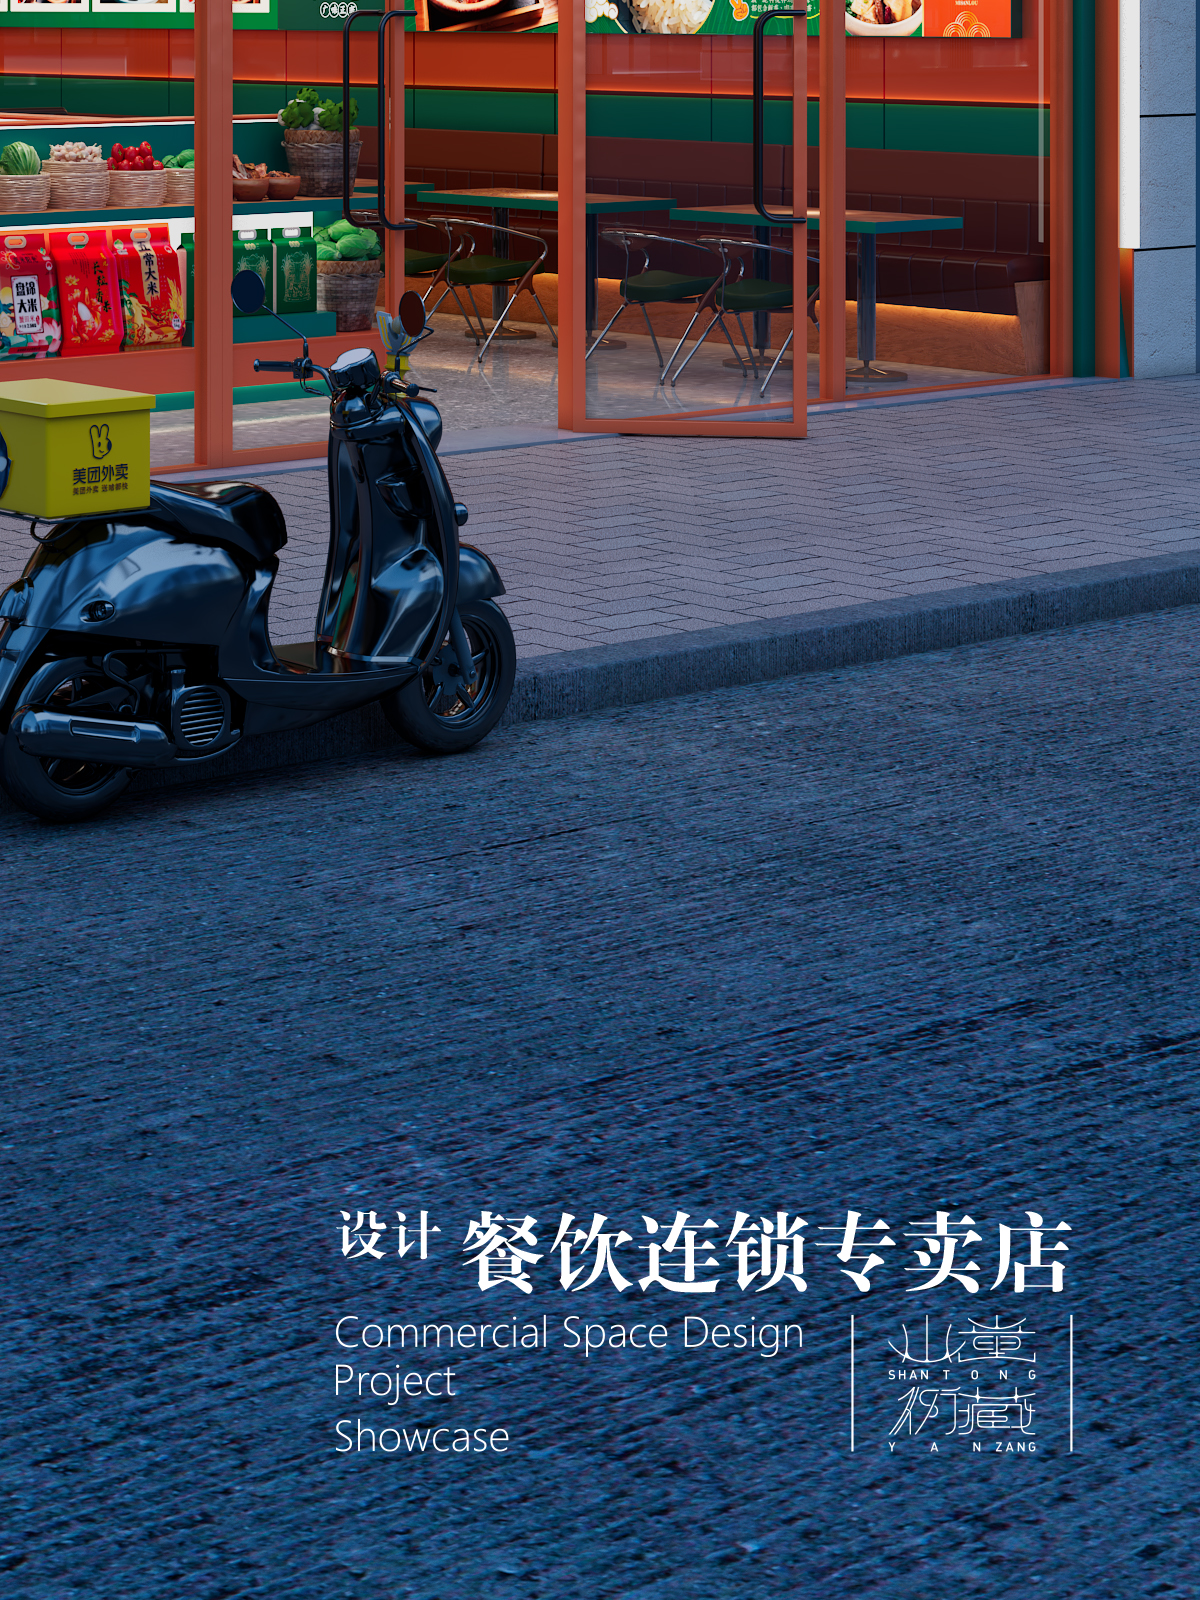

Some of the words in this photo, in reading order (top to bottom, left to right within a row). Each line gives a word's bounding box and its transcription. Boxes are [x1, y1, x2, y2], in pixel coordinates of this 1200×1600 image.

[137, 240, 160, 296] 五常大米
[15, 280, 37, 297] 盘锦
[16, 298, 38, 314] 大米
[72, 462, 129, 486] 美团外卖
[72, 485, 99, 496] 美团外卖
